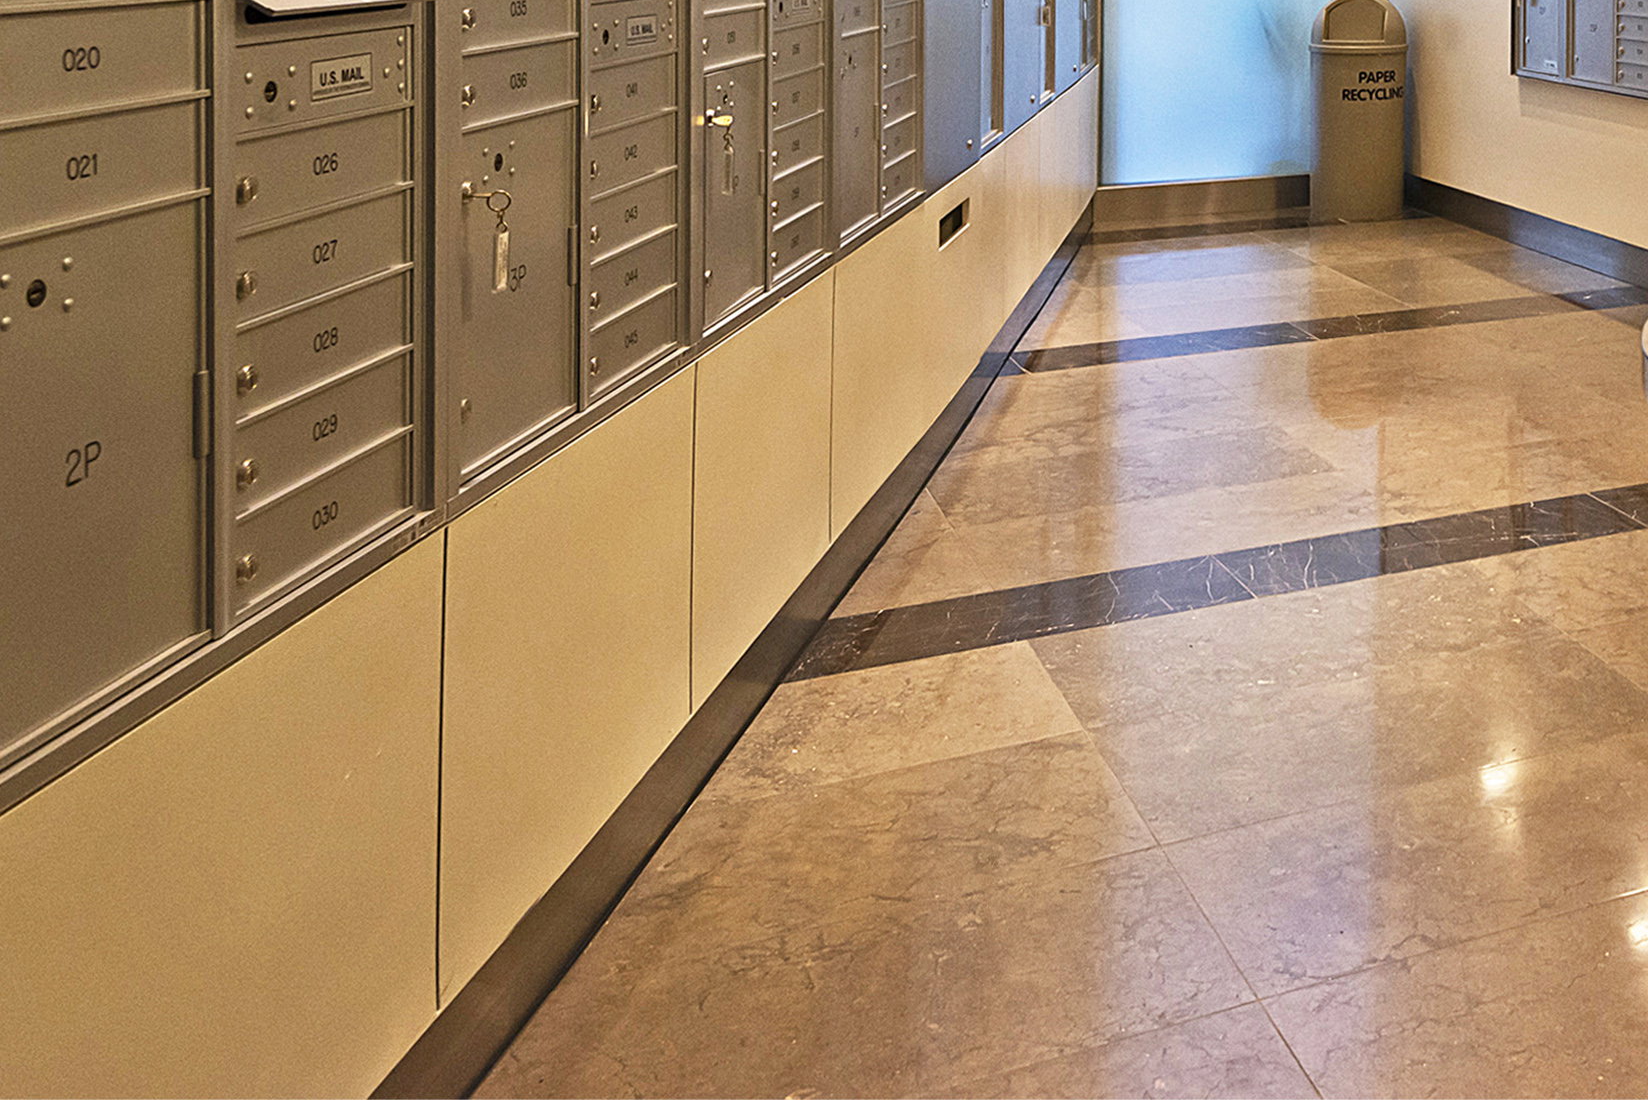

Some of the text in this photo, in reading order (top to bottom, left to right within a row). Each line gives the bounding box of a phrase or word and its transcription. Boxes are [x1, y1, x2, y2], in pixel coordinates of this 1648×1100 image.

[511, 0, 527, 17] 035
[63, 46, 100, 72] 020
[320, 66, 365, 86] U.S. MAIL
[510, 72, 527, 89] 036
[1358, 70, 1396, 84] PAPER
[67, 154, 97, 180] 021
[314, 153, 338, 175] 026
[313, 240, 337, 264] 027
[314, 327, 338, 352] 028
[313, 414, 337, 441] 029
[66, 441, 101, 487] 2P
[313, 501, 338, 530] 030
